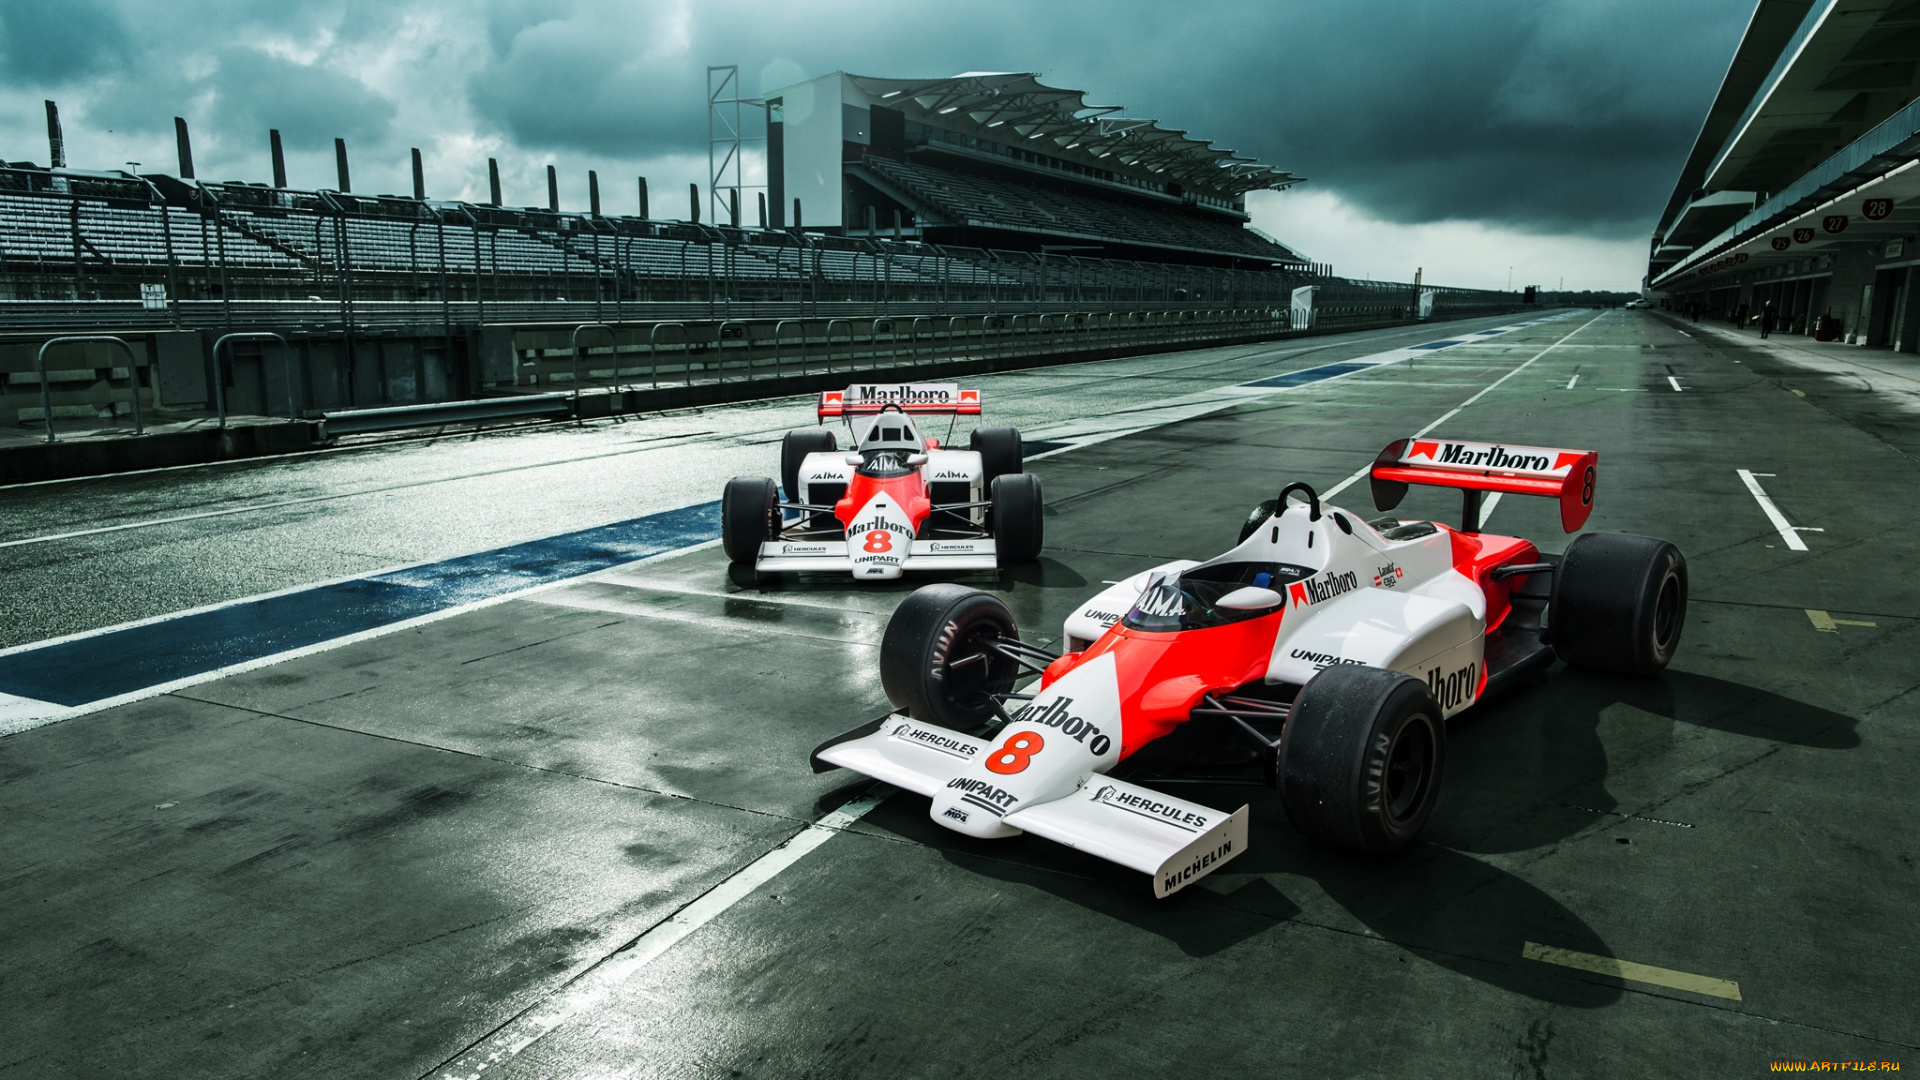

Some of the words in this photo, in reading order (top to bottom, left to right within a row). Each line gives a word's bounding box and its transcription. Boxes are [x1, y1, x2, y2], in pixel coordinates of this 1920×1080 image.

[1868, 201, 1886, 217] 28
[1797, 230, 1810, 241] 26
[1828, 217, 1843, 231] 27
[1775, 239, 1787, 249] 25
[859, 384, 950, 404] Marlboro
[1438, 442, 1550, 472] Marlboro
[1582, 464, 1595, 507] 8
[847, 515, 913, 540] Marlboro
[863, 529, 893, 553] 8
[854, 555, 900, 564] UNIPART
[1308, 569, 1358, 608] Marlboro
[1084, 608, 1122, 625] UNIP
[1429, 661, 1476, 711] lboro
[1014, 695, 1112, 757] arlboro
[909, 728, 980, 756] HERCULES
[984, 730, 1045, 775] 8
[946, 776, 1020, 808] UNIPART
[944, 809, 968, 823] MP4
[1117, 790, 1209, 829] HERCULES
[1163, 839, 1233, 893] MICHELIN
